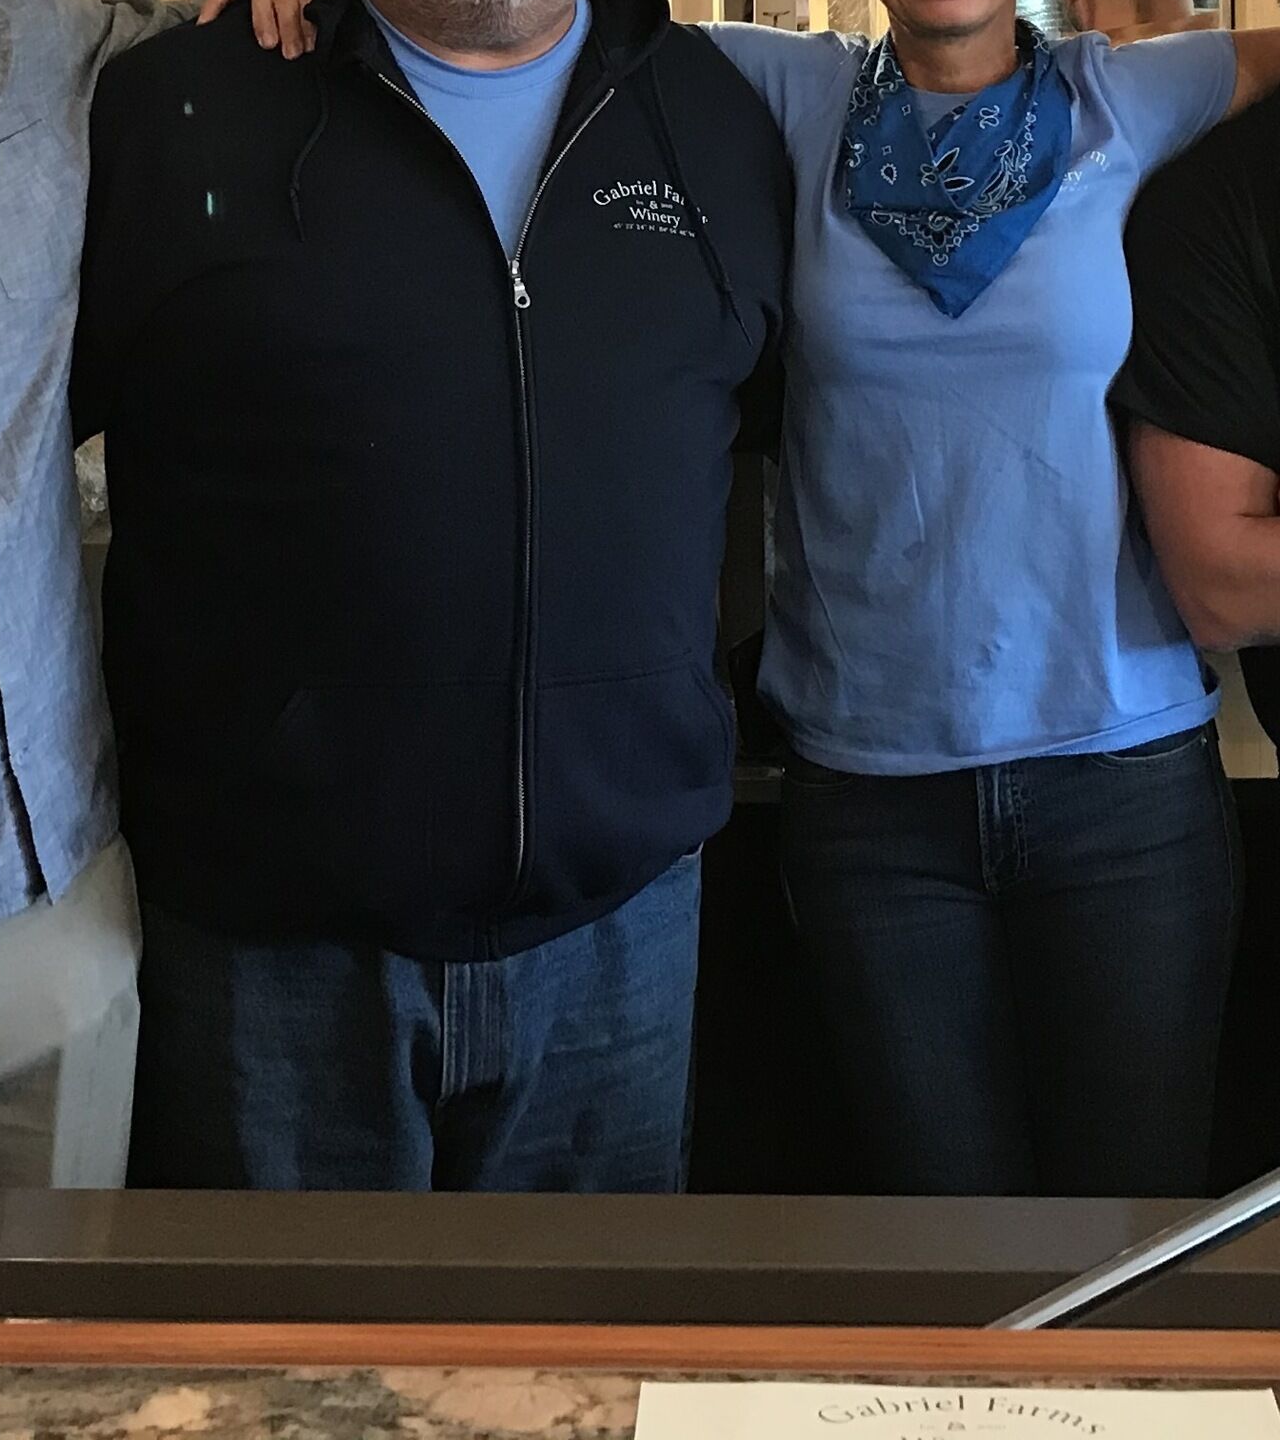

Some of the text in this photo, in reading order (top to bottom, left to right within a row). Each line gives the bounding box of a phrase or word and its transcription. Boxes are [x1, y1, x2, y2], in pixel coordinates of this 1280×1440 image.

[592, 180, 658, 206] Gabriel
[649, 200, 659, 210] &
[628, 206, 681, 229] Winery
[818, 1395, 1106, 1435] Gabriel Farms
